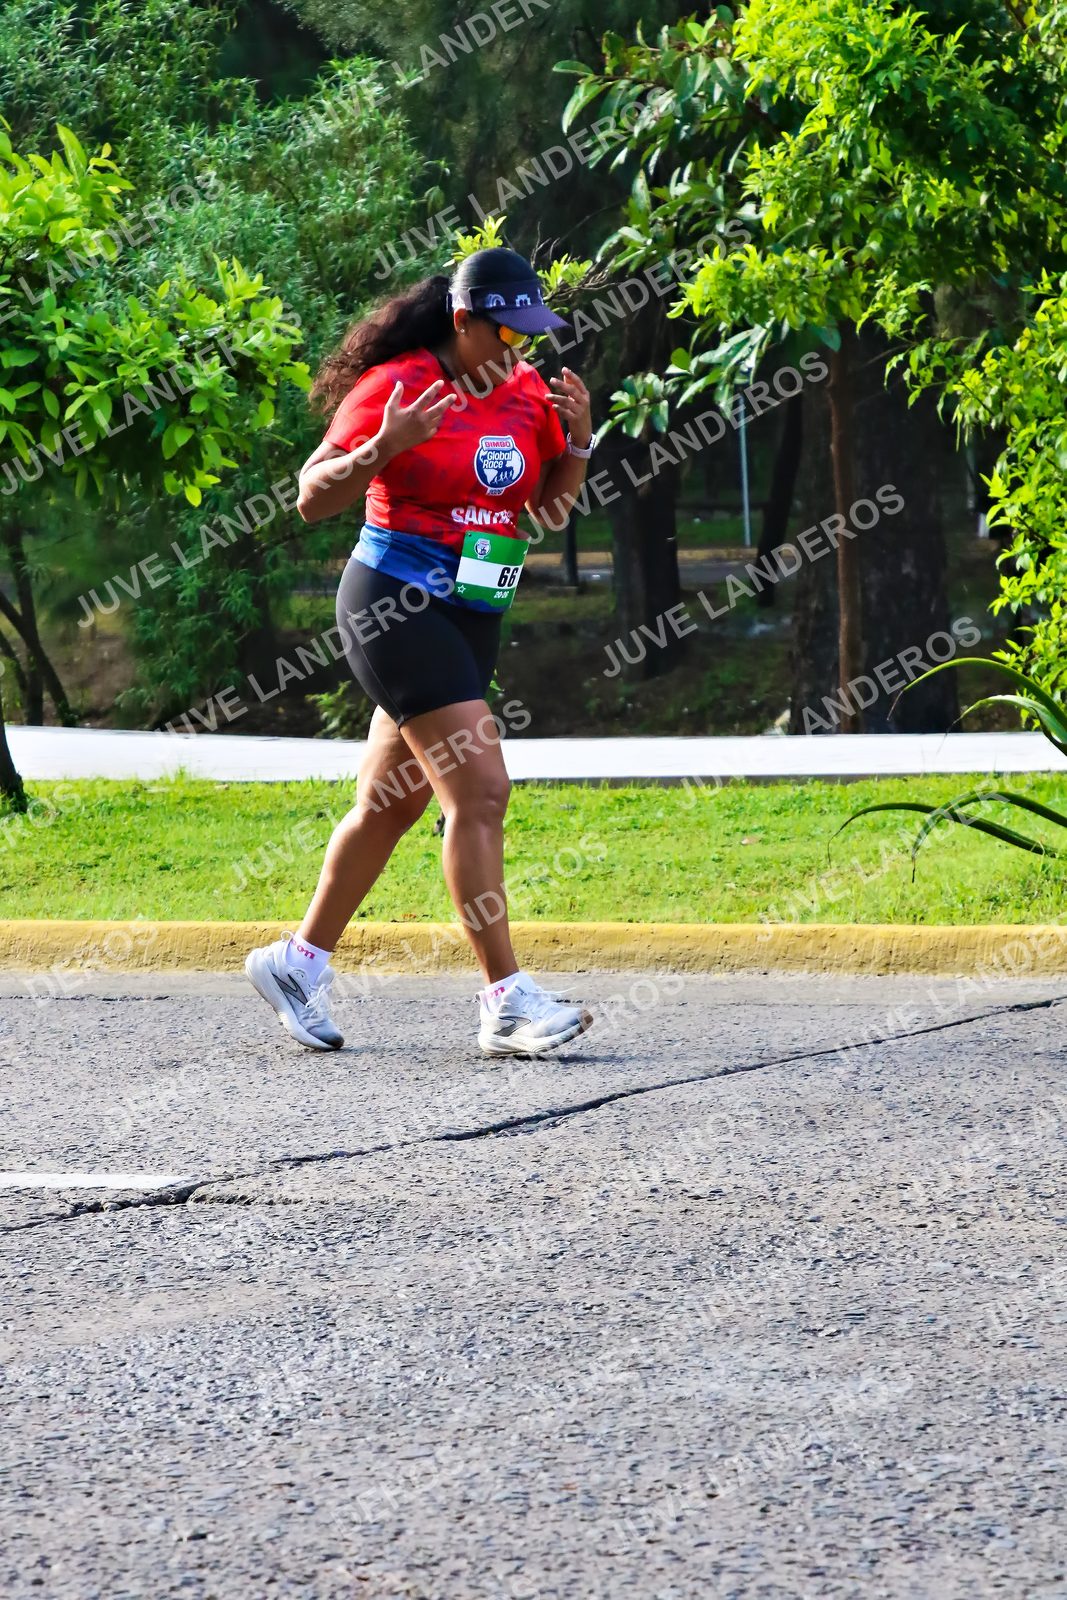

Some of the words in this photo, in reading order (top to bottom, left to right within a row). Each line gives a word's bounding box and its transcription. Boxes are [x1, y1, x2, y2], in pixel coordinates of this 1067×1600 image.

[487, 450, 512, 461] Global
[483, 460, 503, 468] Race
[451, 505, 514, 524] SAN
[498, 567, 519, 587] 66
